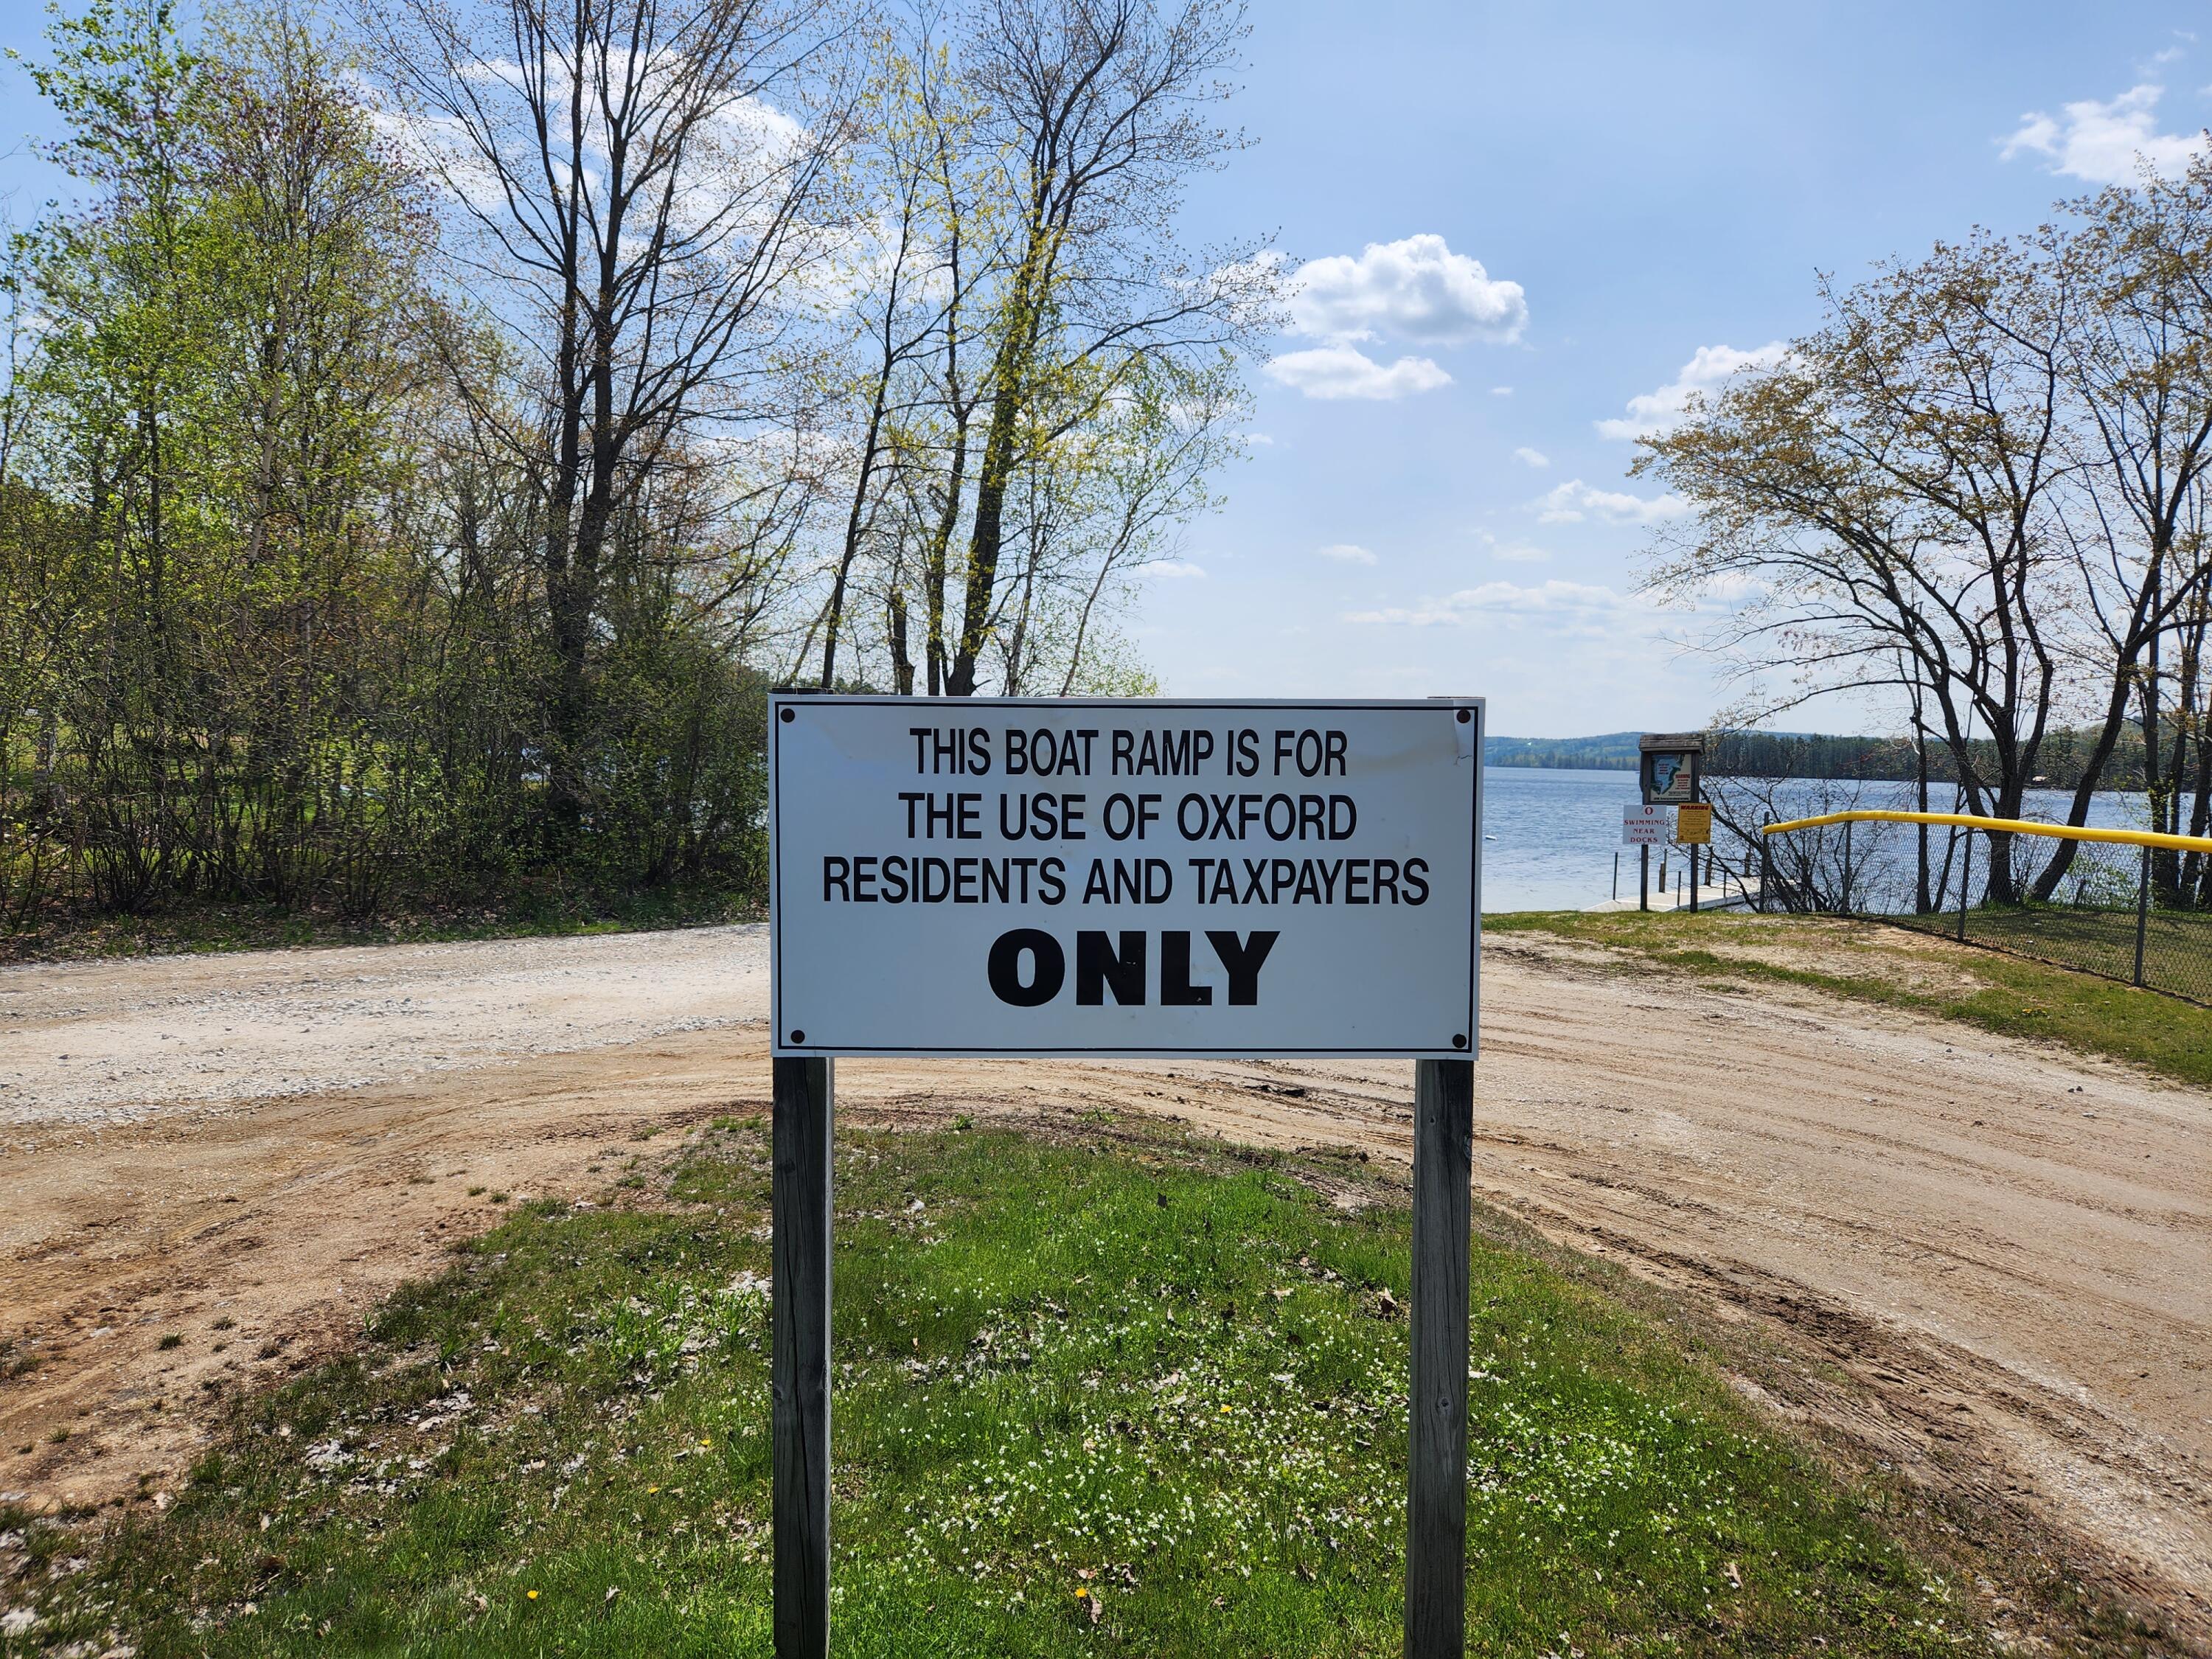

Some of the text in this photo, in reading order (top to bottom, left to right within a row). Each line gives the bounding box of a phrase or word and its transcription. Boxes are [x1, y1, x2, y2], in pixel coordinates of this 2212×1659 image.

[909, 727, 1348, 778] THIS BOAT RAMP IS FOR
[897, 792, 1357, 842] THE USE OF OXFORD
[824, 855, 1430, 906] RESIDENTS AND TAXPAYERS
[987, 928, 1281, 1007] ONLY
